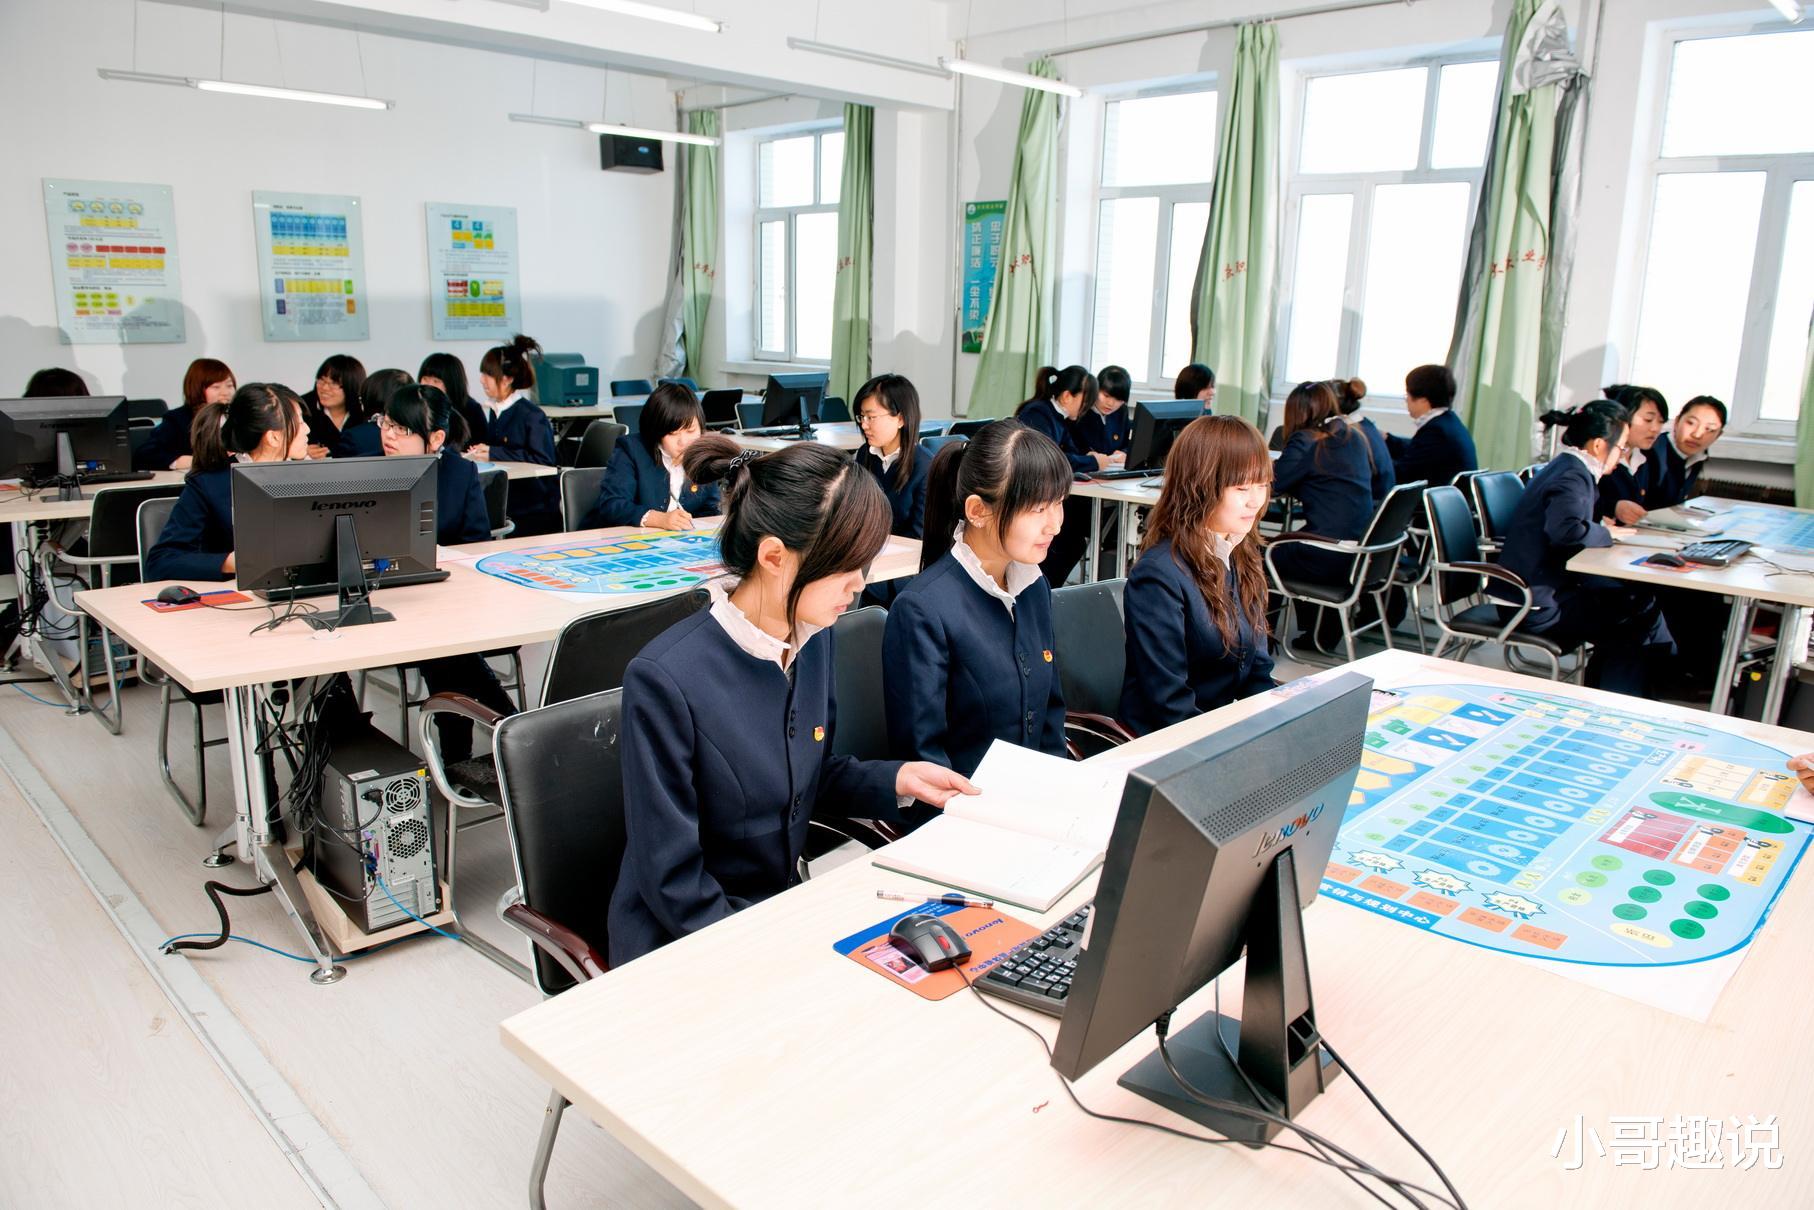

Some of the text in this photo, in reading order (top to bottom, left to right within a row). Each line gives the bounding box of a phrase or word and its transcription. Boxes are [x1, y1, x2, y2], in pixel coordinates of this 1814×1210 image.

[311, 500, 377, 511] lenovo
[1252, 802, 1325, 858] lenovo
[965, 918, 1004, 937] lenovo
